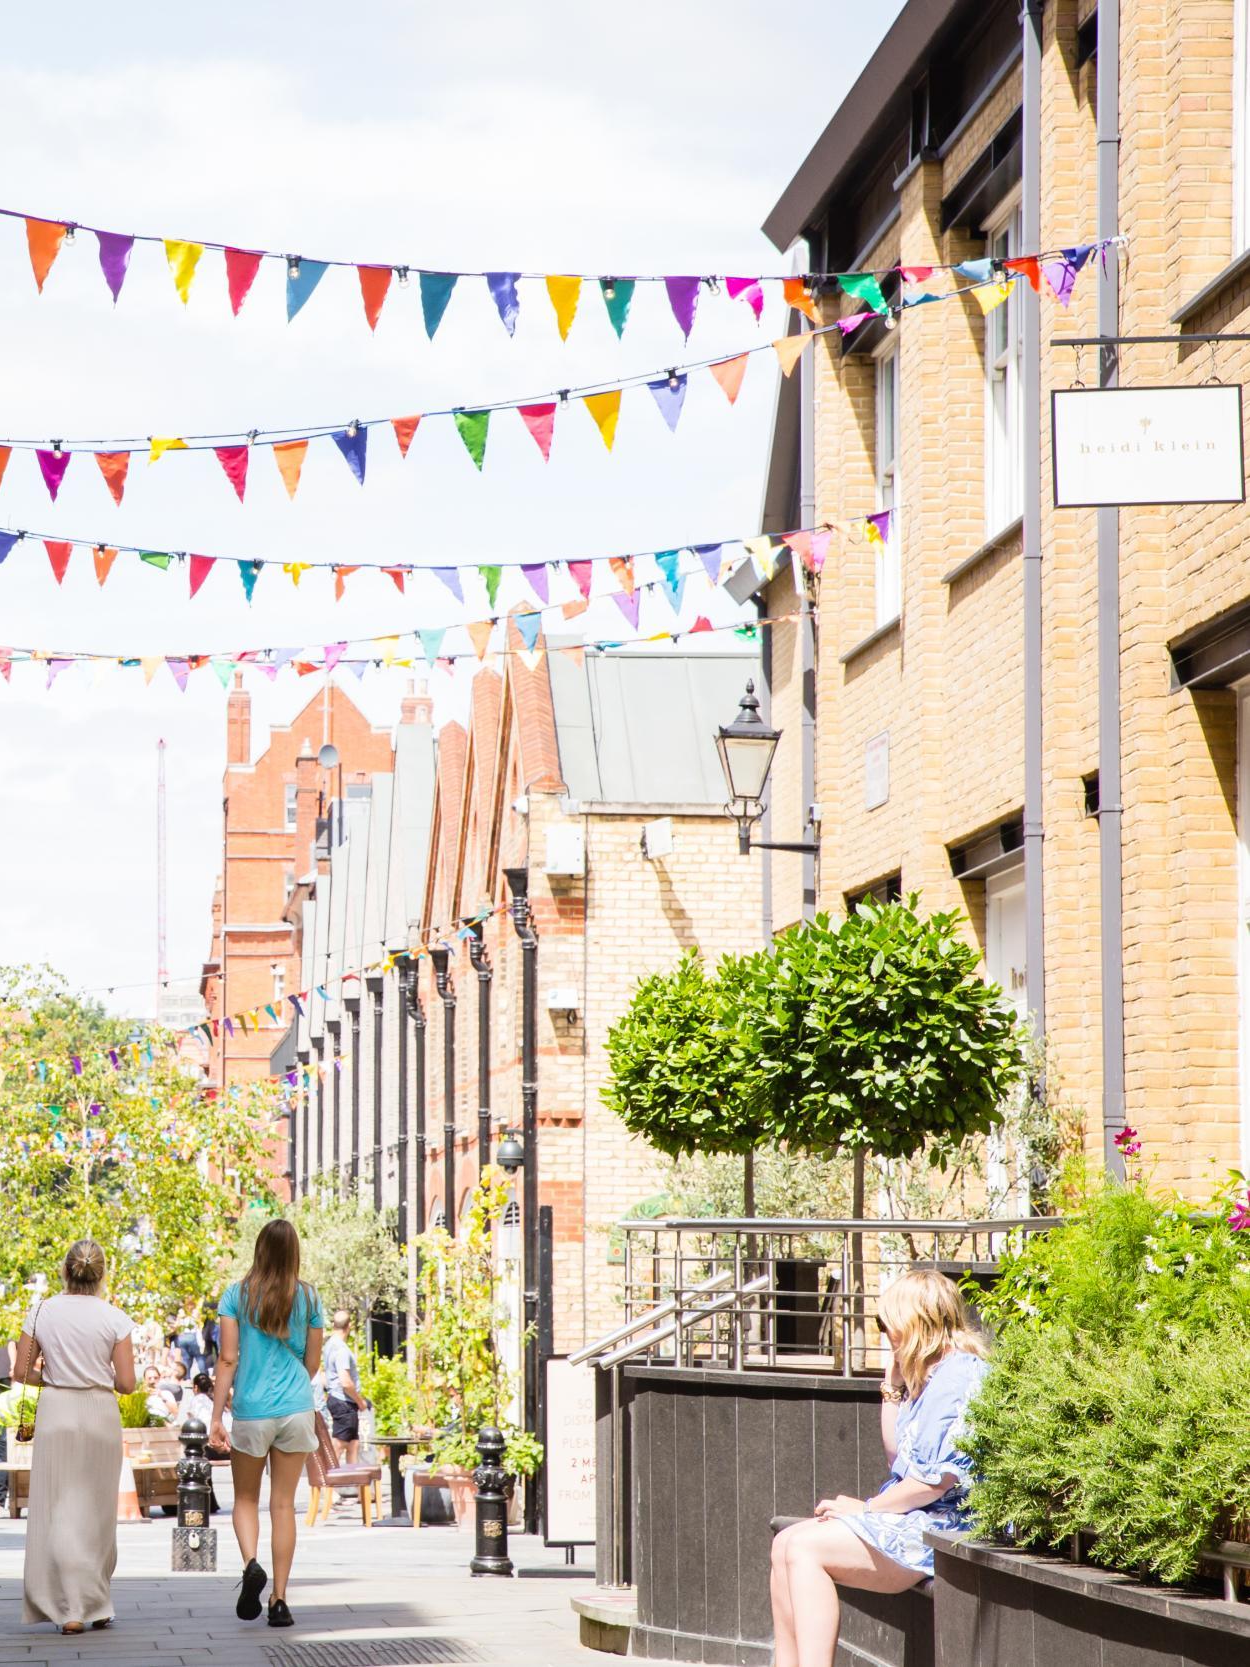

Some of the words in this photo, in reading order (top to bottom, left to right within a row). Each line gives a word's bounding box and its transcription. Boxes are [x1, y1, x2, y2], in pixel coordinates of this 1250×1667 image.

[1080, 441, 1141, 454] heidi
[1154, 440, 1215, 452] klein
[571, 1457, 578, 1468] 2
[557, 1489, 591, 1501] FROM
